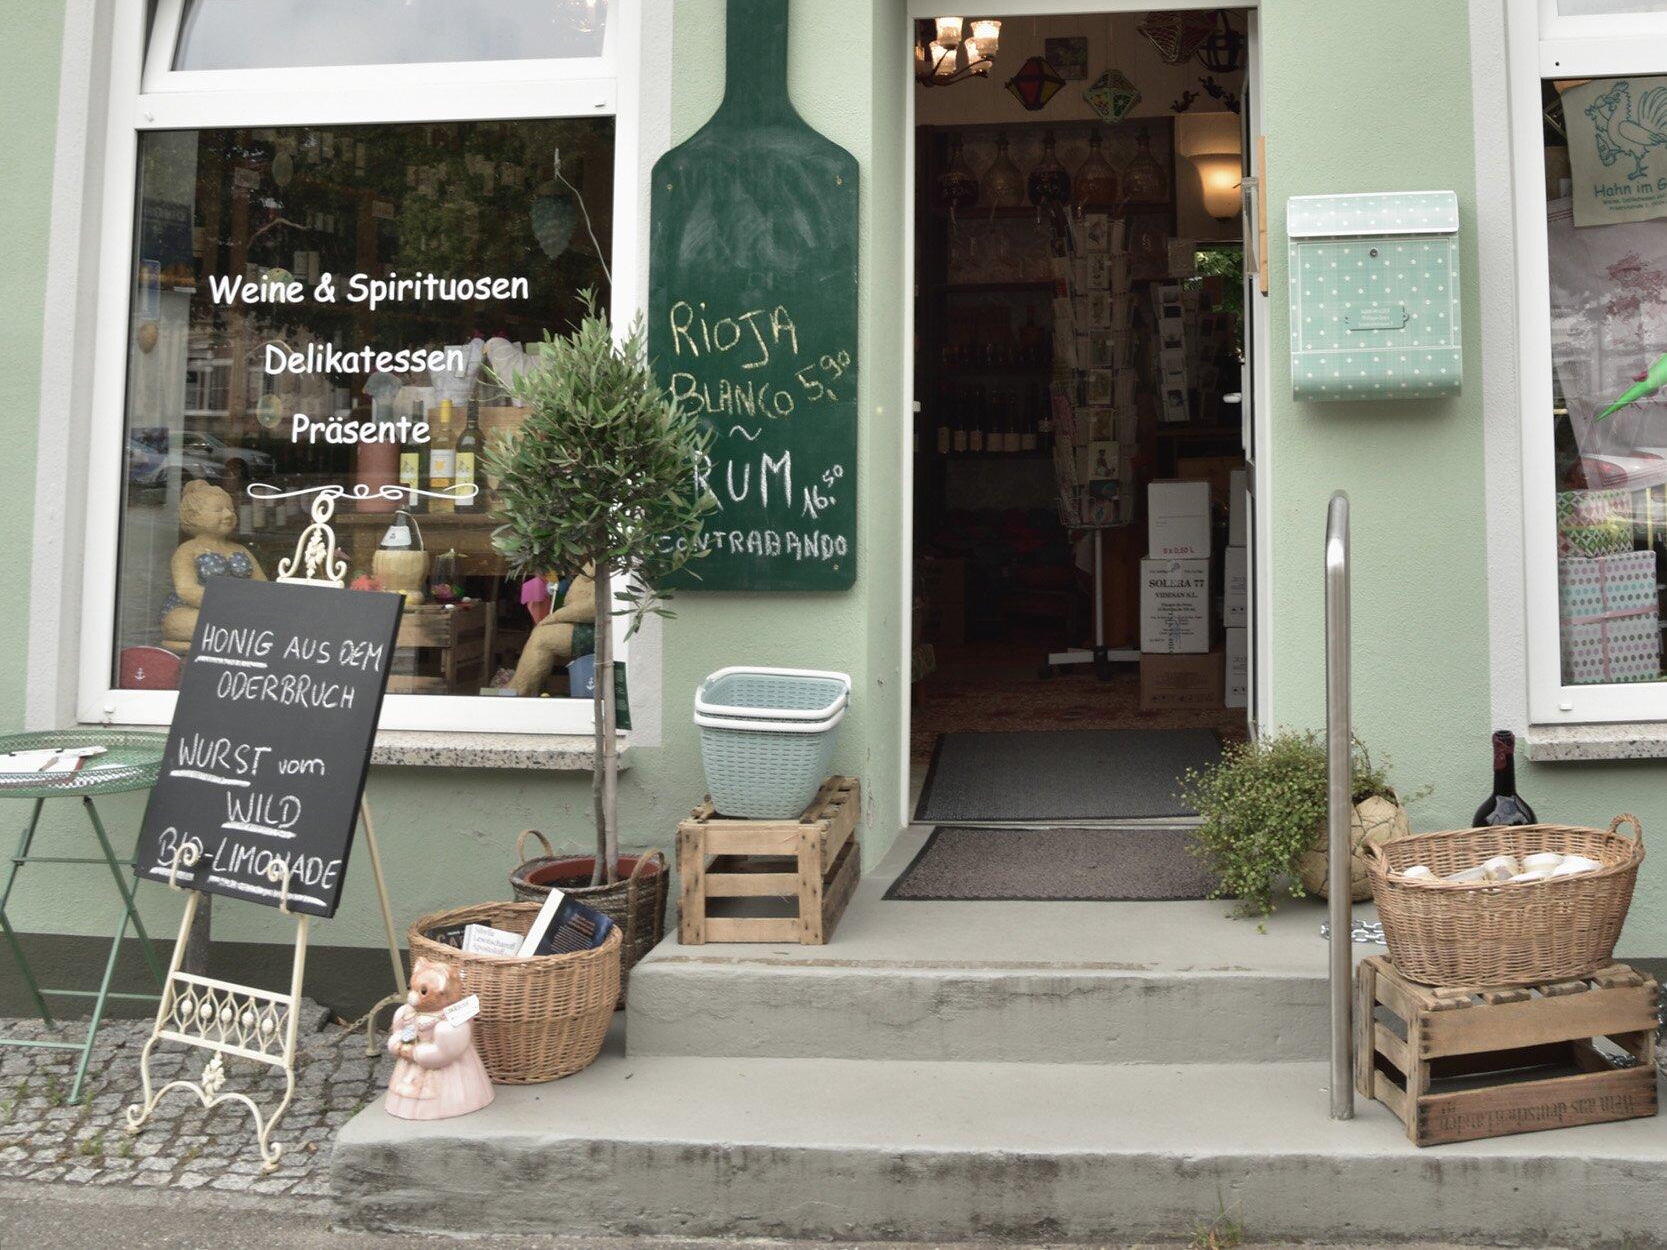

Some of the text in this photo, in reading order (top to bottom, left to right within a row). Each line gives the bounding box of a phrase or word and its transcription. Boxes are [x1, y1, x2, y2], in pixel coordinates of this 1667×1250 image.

[1594, 183, 1631, 197] Hahn
[1636, 181, 1652, 193] im
[208, 272, 530, 310] Weine & Spirituosen
[264, 343, 464, 375] Delikatessen
[670, 373, 795, 419] BLANCO
[290, 413, 431, 444] Präsente
[693, 449, 791, 510] RUM
[656, 529, 849, 561] CONTRABANDO
[1148, 578, 1205, 588] SOLERA 77
[202, 623, 383, 672] HONIG AUS DEM
[216, 671, 355, 709] ODERBRUCH
[177, 732, 325, 776] WURST vom
[226, 791, 301, 828] WILD
